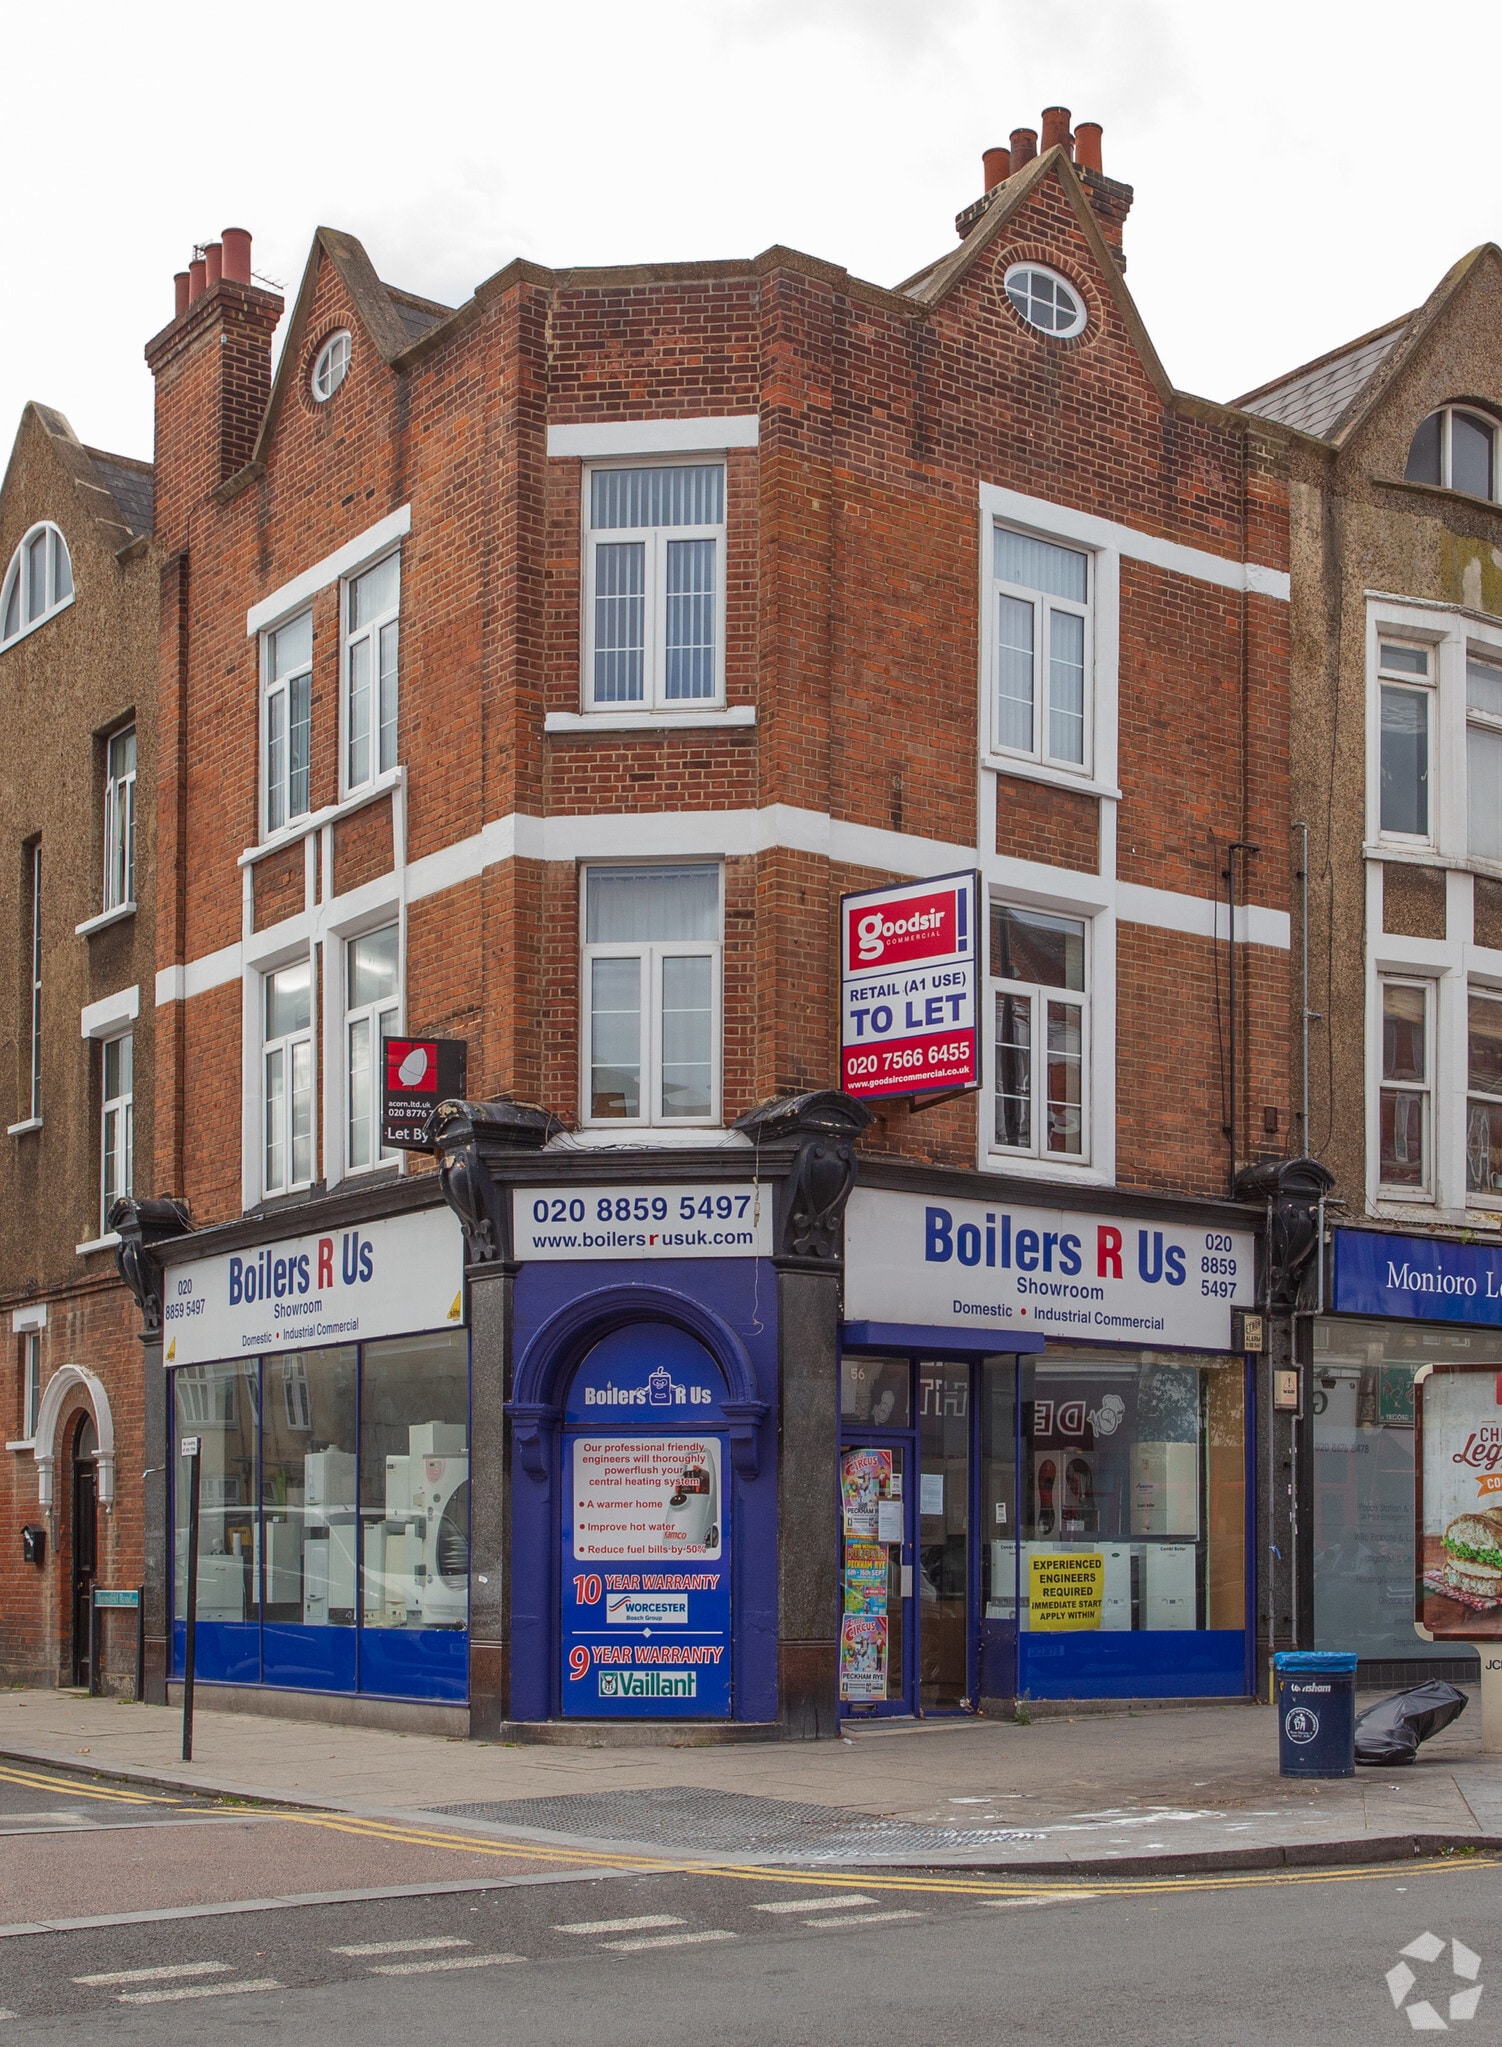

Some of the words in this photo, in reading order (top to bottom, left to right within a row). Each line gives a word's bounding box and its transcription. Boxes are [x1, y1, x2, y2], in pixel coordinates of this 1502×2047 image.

[857, 908, 945, 961] goodsir
[886, 930, 941, 946] COMMERCIAL
[850, 983, 900, 1002] RETAIL
[904, 977, 926, 997] (A1
[932, 971, 967, 988] USE)
[850, 1005, 893, 1037] TO
[905, 992, 967, 1029] LET
[847, 1055, 879, 1075] 020
[883, 1048, 924, 1071] 7566
[928, 1041, 970, 1065] 6455
[847, 1065, 970, 1090] www.goodsircommercial.co.uk
[388, 1101, 431, 1109] acorn.ltd.uk
[388, 1108, 405, 1117] 020
[406, 1109, 427, 1118] 8776
[387, 1127, 410, 1140] Let
[413, 1127, 429, 1143] By
[533, 1198, 586, 1223] 020
[596, 1197, 668, 1222] 8859
[679, 1195, 752, 1220] 5497
[532, 1229, 754, 1248] www.boilersrusuk.com
[925, 1205, 1082, 1277] Boilers
[1097, 1224, 1123, 1280] R
[1138, 1229, 1187, 1287] Us
[1205, 1232, 1233, 1254] 020
[229, 1250, 310, 1306] Boilers
[318, 1237, 334, 1290] R
[342, 1231, 374, 1285] Us
[1201, 1256, 1237, 1277] 8859
[177, 1278, 193, 1296] 020
[1016, 1276, 1104, 1301] Showroom
[1201, 1278, 1237, 1300] 5497
[1386, 1261, 1477, 1297] Monioro
[165, 1304, 185, 1321] 8859
[186, 1298, 206, 1317] 5497
[273, 1299, 323, 1319] Showroom
[952, 1299, 1013, 1318] Domestic
[1034, 1306, 1092, 1325] Industrial
[1094, 1311, 1165, 1331] Commercial
[242, 1331, 273, 1347] Domestic
[283, 1324, 316, 1341] Industrial
[316, 1317, 360, 1336] Commercial
[850, 1368, 865, 1380] 56
[585, 1386, 647, 1405] Boilers
[675, 1386, 687, 1405] R
[690, 1386, 712, 1405] Us
[583, 1443, 602, 1452] Our
[604, 1443, 665, 1454] professional
[667, 1442, 705, 1454] friendly
[1452, 1433, 1502, 1471] Leg
[582, 1455, 630, 1465] engineers
[633, 1454, 650, 1463] will
[652, 1454, 706, 1466] thoroughly
[845, 1456, 879, 1477] CIRCUS
[604, 1466, 659, 1477] powerflush
[661, 1467, 684, 1477] your
[589, 1477, 622, 1486] central
[625, 1477, 661, 1487] heating
[664, 1478, 700, 1487] system
[1487, 1477, 1502, 1489] CO
[587, 1500, 594, 1509] A
[635, 1500, 663, 1509] home
[587, 1523, 627, 1533] Improve
[630, 1522, 647, 1531] hot
[649, 1523, 675, 1531] water
[587, 1545, 625, 1554] Reduce
[627, 1545, 646, 1554] fuel
[649, 1545, 668, 1554] bills
[671, 1545, 684, 1556] by
[686, 1545, 707, 1554] 50%
[1033, 1559, 1102, 1570] EXPERIENCED
[1039, 1573, 1096, 1584] ENGINEERS
[573, 1574, 602, 1605] 10
[605, 1574, 640, 1590] YEAR
[642, 1574, 720, 1590] WARRANTY
[1042, 1587, 1093, 1597] REQUIRED
[625, 1603, 686, 1612] WORCESTER
[1031, 1600, 1077, 1610] IMMEDIATE
[1078, 1599, 1103, 1608] START
[1039, 1612, 1066, 1621] APPLY
[1067, 1611, 1096, 1619] WITHIN
[845, 1622, 876, 1642] CIRCUS
[569, 1645, 591, 1681] 9
[592, 1646, 632, 1664] YEAR
[635, 1646, 724, 1664] WARRANTY
[619, 1672, 696, 1696] Vaillant
